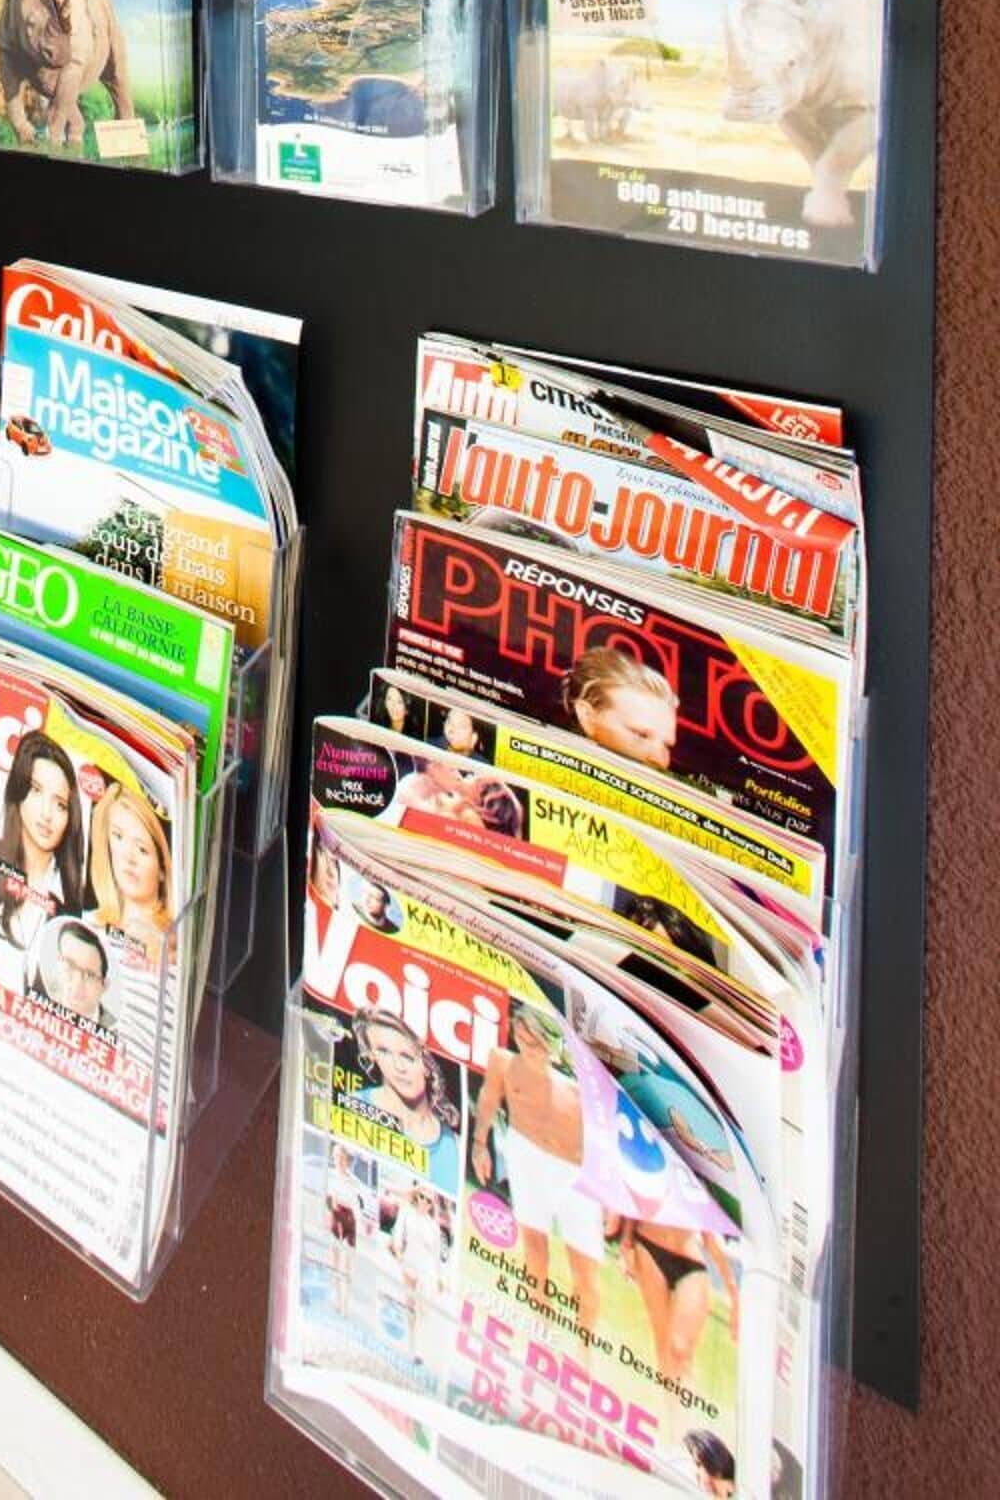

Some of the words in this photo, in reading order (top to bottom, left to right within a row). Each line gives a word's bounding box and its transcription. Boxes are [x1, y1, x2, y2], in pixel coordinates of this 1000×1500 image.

[665, 187, 766, 219] animaux
[667, 209, 697, 233] 20
[702, 211, 811, 250] hectares
[35, 395, 221, 485] magazine
[119, 500, 158, 537] Un
[144, 536, 172, 566] de
[95, 543, 145, 583] dans
[150, 560, 168, 591] la
[172, 580, 257, 625] maison
[504, 558, 647, 626] RÉPONSES
[91, 608, 186, 662] CALIFORNIE
[411, 528, 817, 772] PHOTO
[341, 779, 363, 794] PRIX
[540, 746, 580, 772] BROWN
[766, 849, 795, 874] Dolls
[744, 778, 813, 817] Portfolios
[534, 796, 610, 843] SHY'M
[784, 813, 811, 833] par
[406, 902, 456, 938] KATY
[303, 865, 500, 1075] Voici
[10, 994, 81, 1050] FAMILLE
[86, 1037, 109, 1067] SE
[304, 1056, 363, 1094] LORIE
[337, 1091, 405, 1137] PRESSION
[469, 1236, 539, 1288] Rachida
[496, 1275, 510, 1293] &
[514, 1284, 615, 1356] Dominique
[618, 1343, 721, 1419] Desseigne
